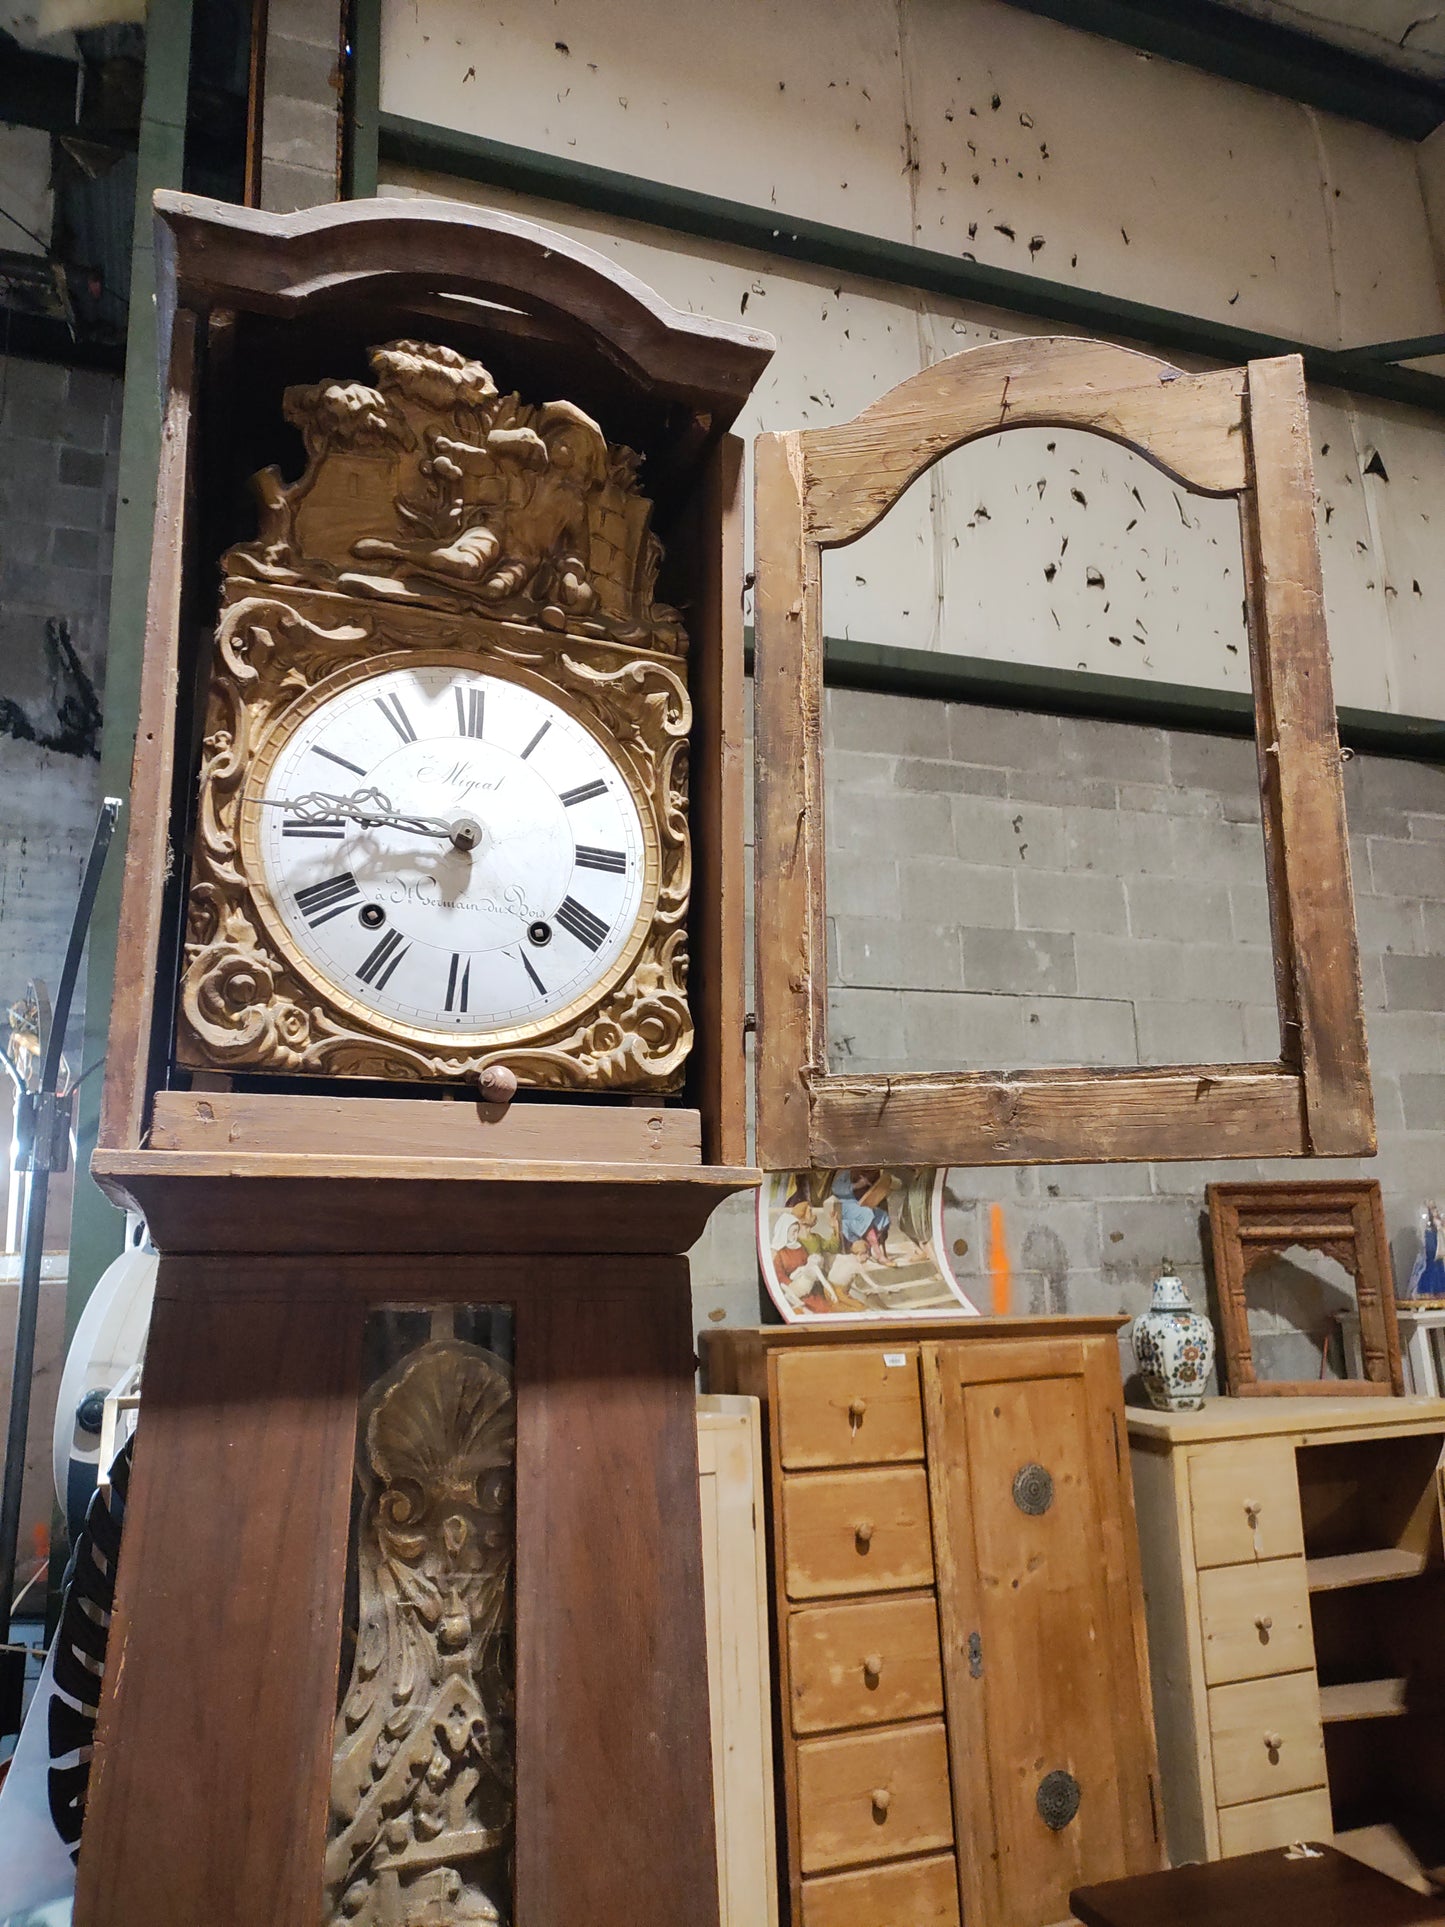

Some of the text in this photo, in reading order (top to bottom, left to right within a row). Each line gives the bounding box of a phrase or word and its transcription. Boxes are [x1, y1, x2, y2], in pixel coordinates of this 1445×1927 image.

[558, 778, 609, 807] II
[575, 844, 626, 874] III
[554, 894, 610, 953] IIII
